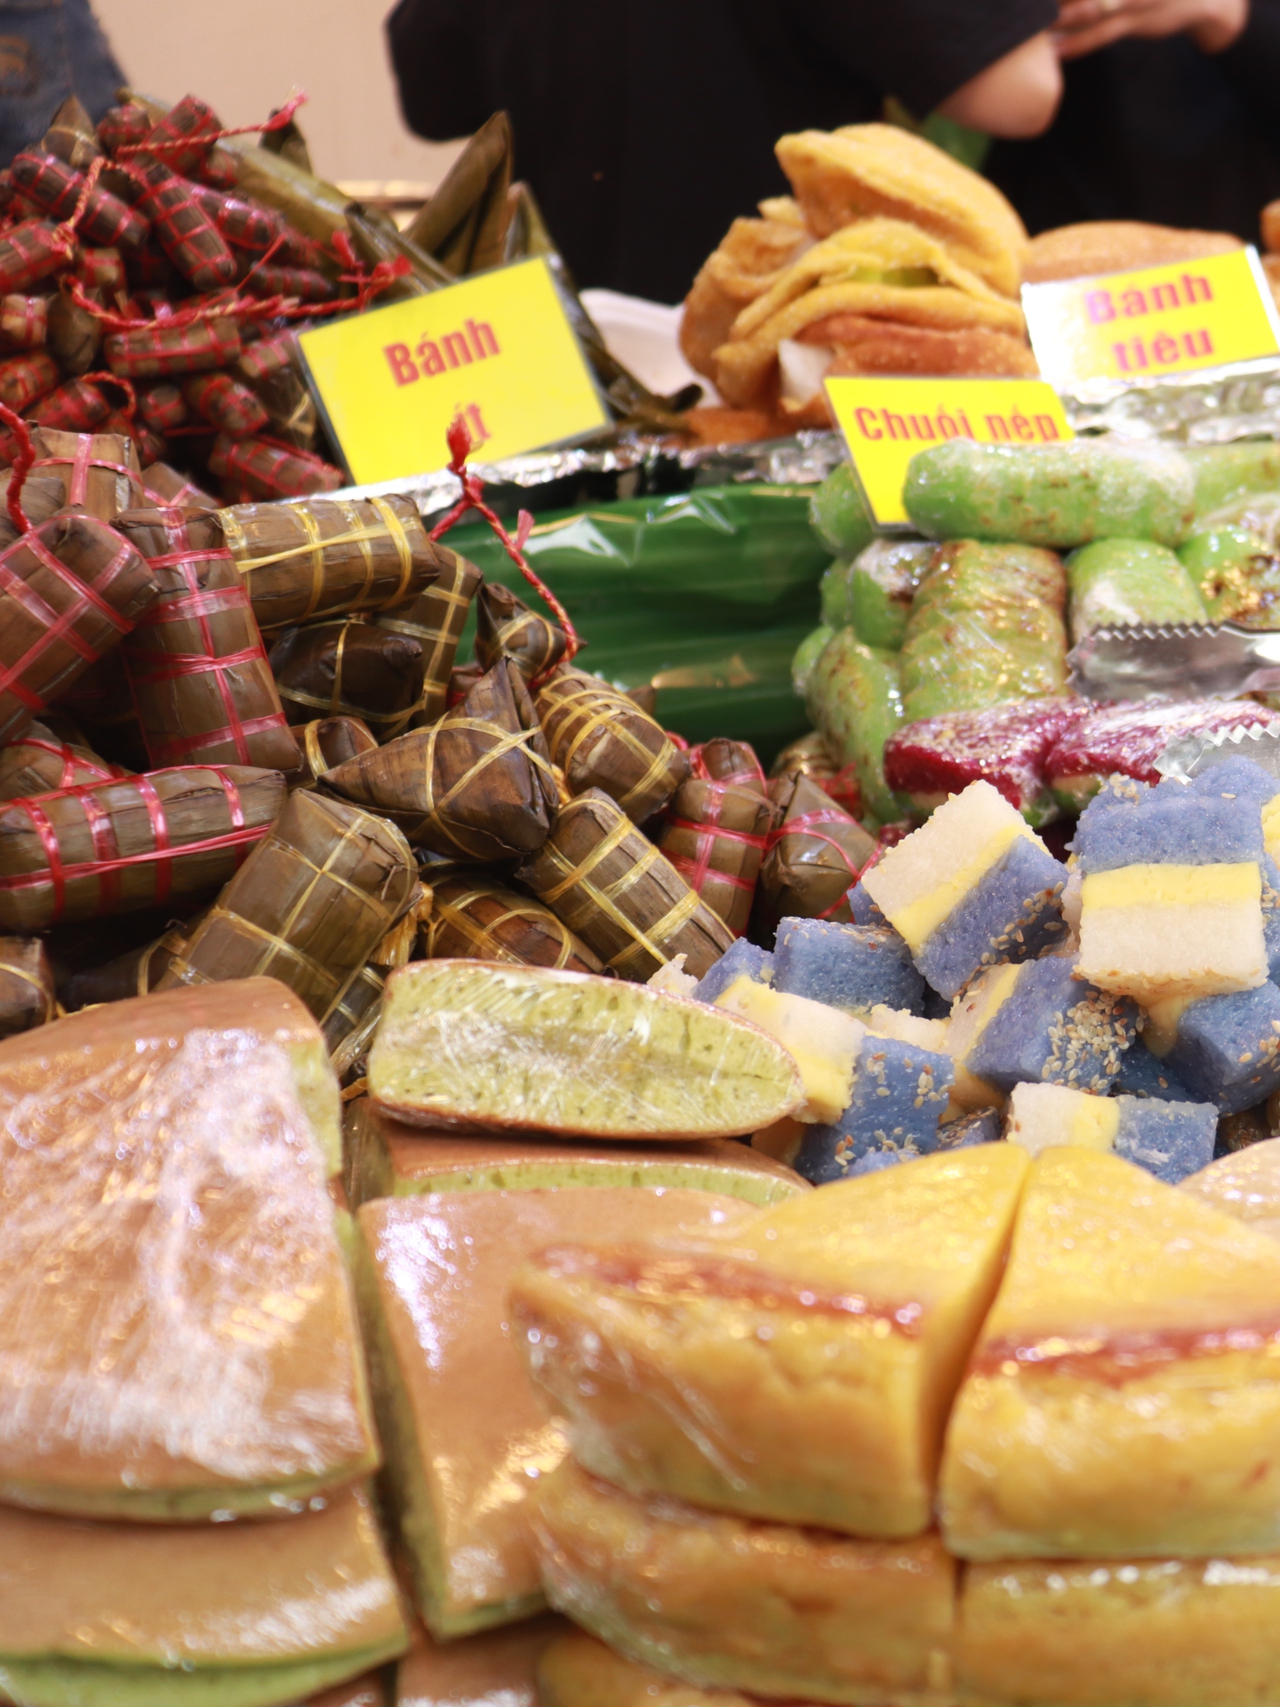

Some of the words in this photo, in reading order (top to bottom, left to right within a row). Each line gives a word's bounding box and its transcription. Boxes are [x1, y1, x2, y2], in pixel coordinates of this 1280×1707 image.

[1085, 273, 1213, 325] Bánh
[382, 318, 501, 388] Bánh
[1112, 328, 1213, 372] tiêu
[854, 403, 975, 441] Chuối
